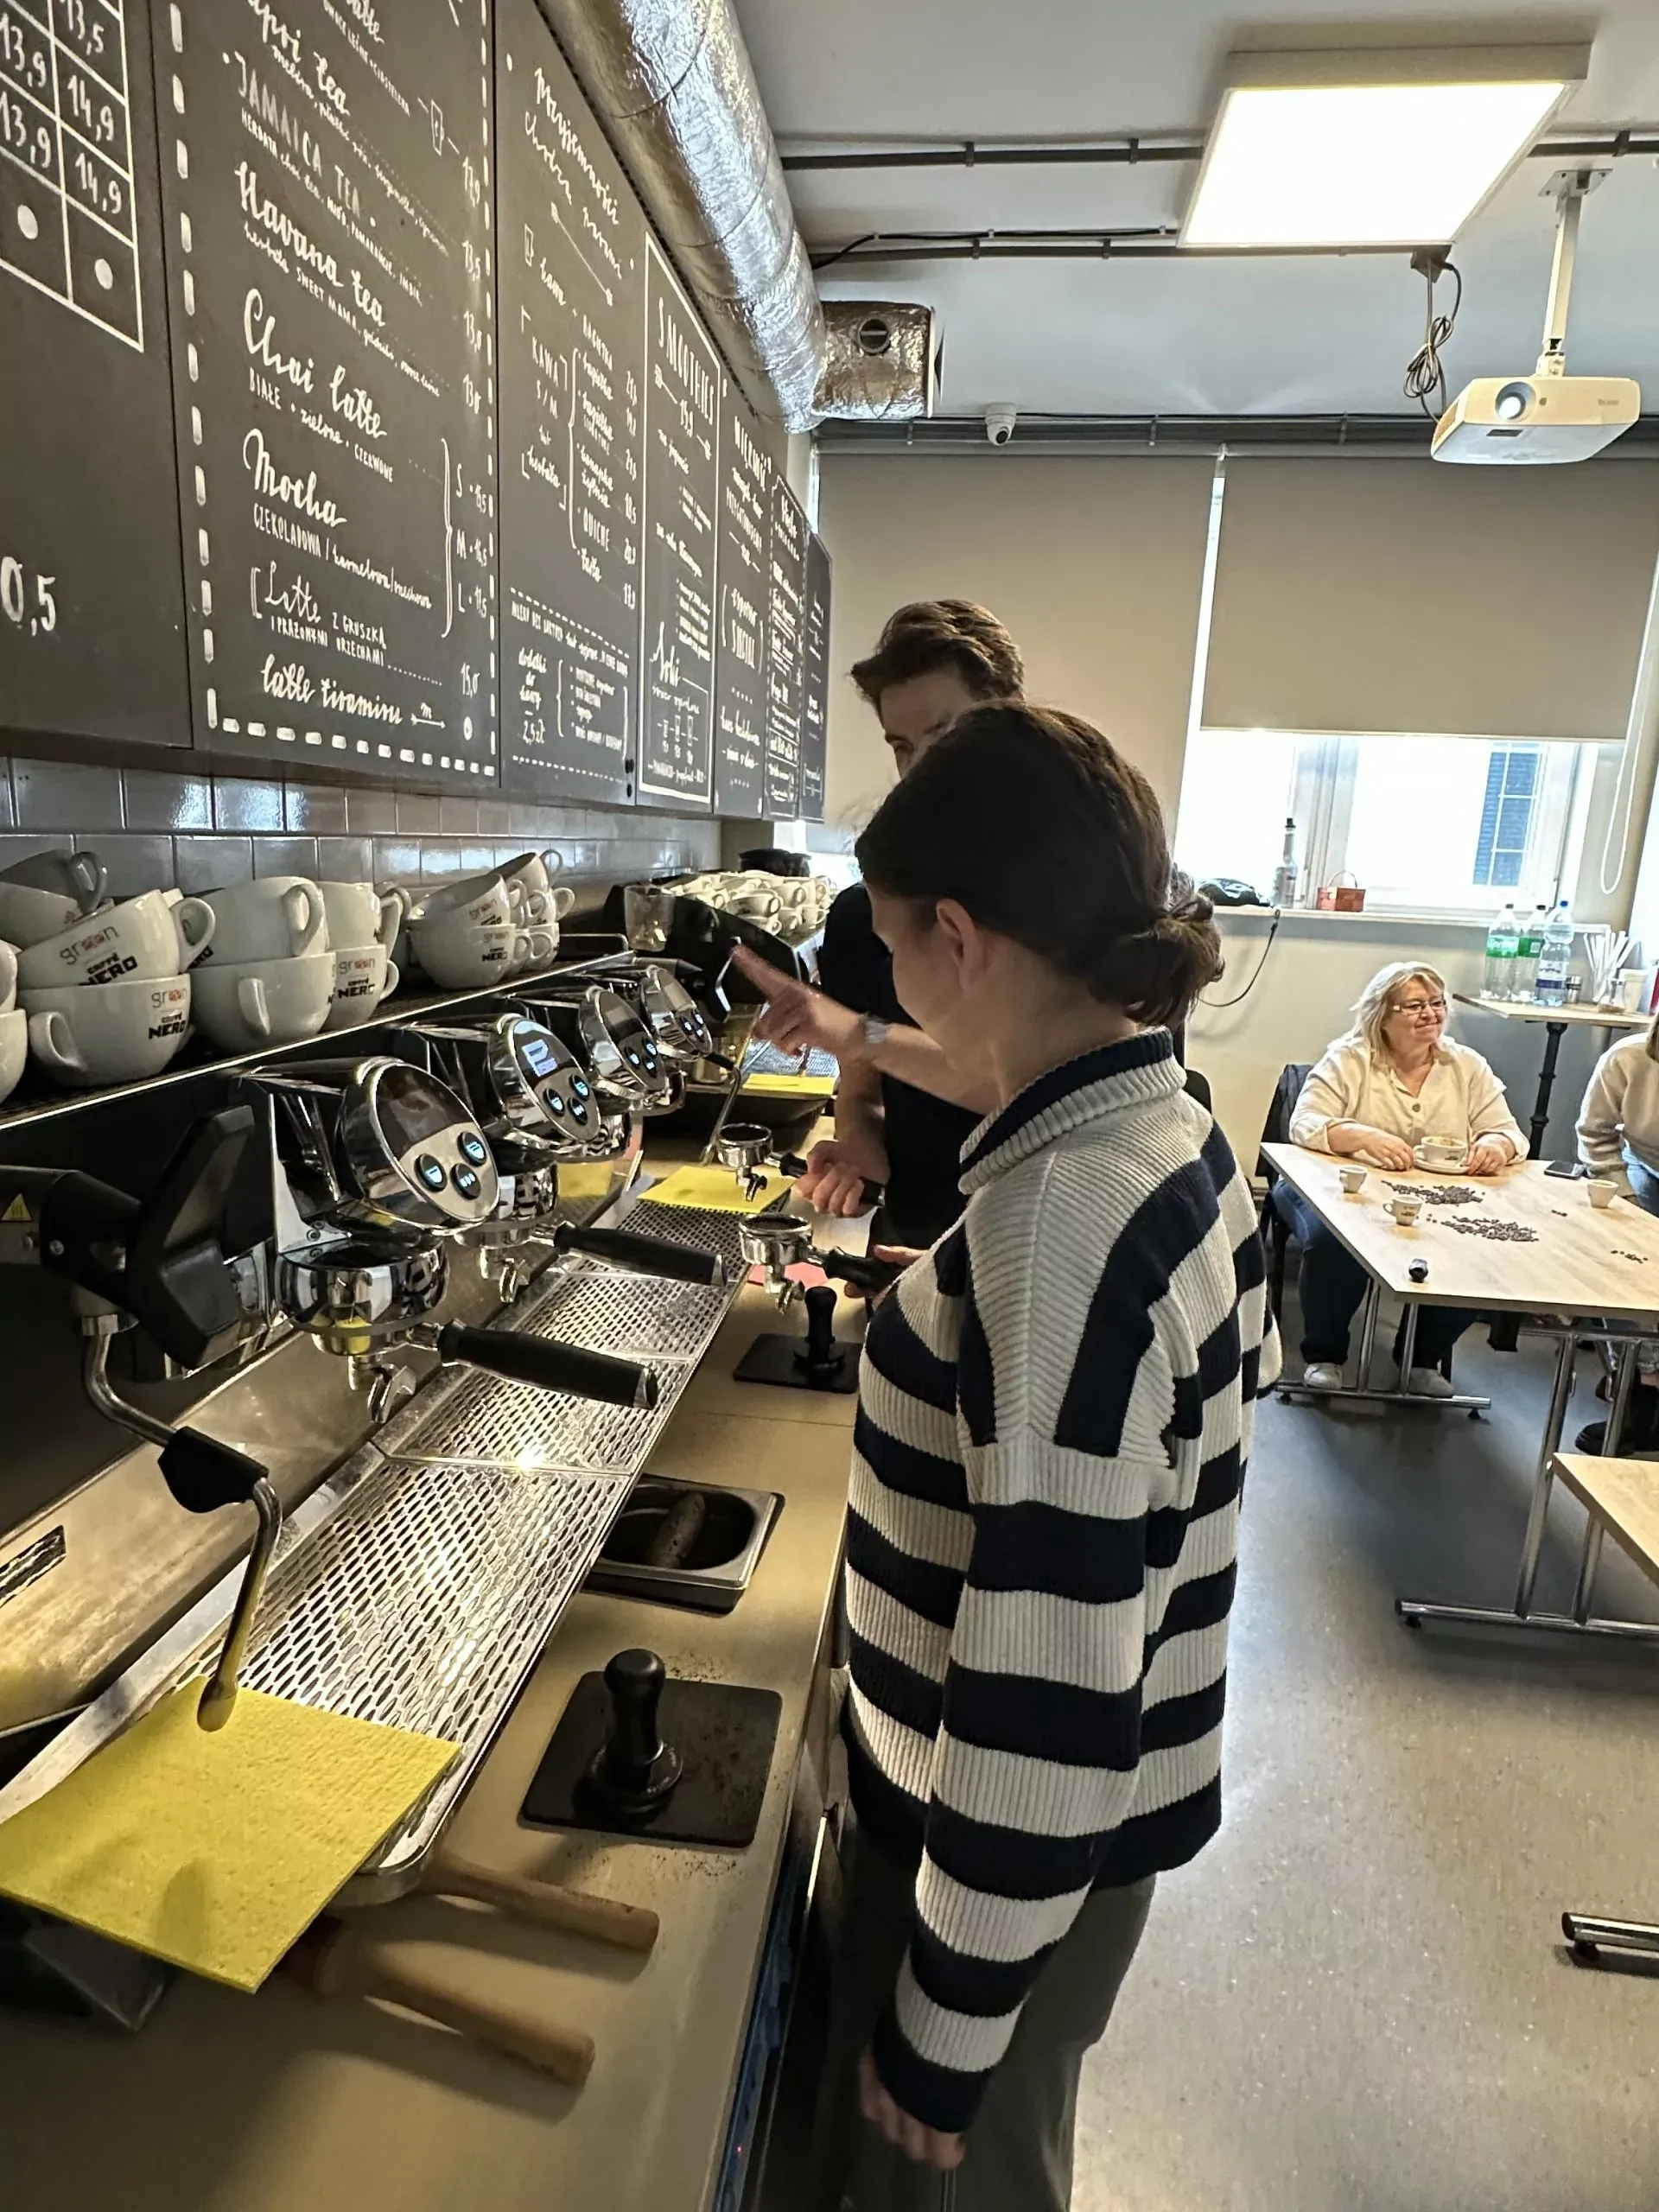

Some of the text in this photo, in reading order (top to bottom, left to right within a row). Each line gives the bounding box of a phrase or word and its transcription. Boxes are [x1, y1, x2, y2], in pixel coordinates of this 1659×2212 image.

[68, 75, 115, 142] 14,9
[235, 51, 321, 176] JAMAICA
[335, 165, 359, 218] TEA
[242, 108, 277, 157] HERBATA
[75, 153, 122, 214] 14,9
[314, 52, 350, 116] tea
[462, 240, 480, 289] 13,5
[234, 162, 344, 287] Havana
[351, 270, 385, 327] tea
[245, 221, 289, 273] herbata
[296, 267, 323, 301] SWEET
[245, 289, 387, 438] Chai latte
[532, 337, 558, 386] KAWA
[659, 297, 714, 425] SMOOTHIES
[250, 367, 392, 482] BIAŁE zielone CZERWONE
[243, 429, 346, 527] Mocha
[456, 463, 462, 498] S
[527, 446, 560, 487] herbata
[254, 503, 321, 557] CZEKOLADOWA
[457, 530, 466, 559] M
[583, 507, 609, 551] QUICHE
[264, 561, 480, 698] Latte Z GRUSZKĄ 15,0
[459, 583, 465, 613] L
[336, 638, 384, 666] ORZECHAMI
[261, 654, 315, 702] latte
[321, 678, 402, 724] tiramisu
[149, 1020, 187, 1039] NERO
